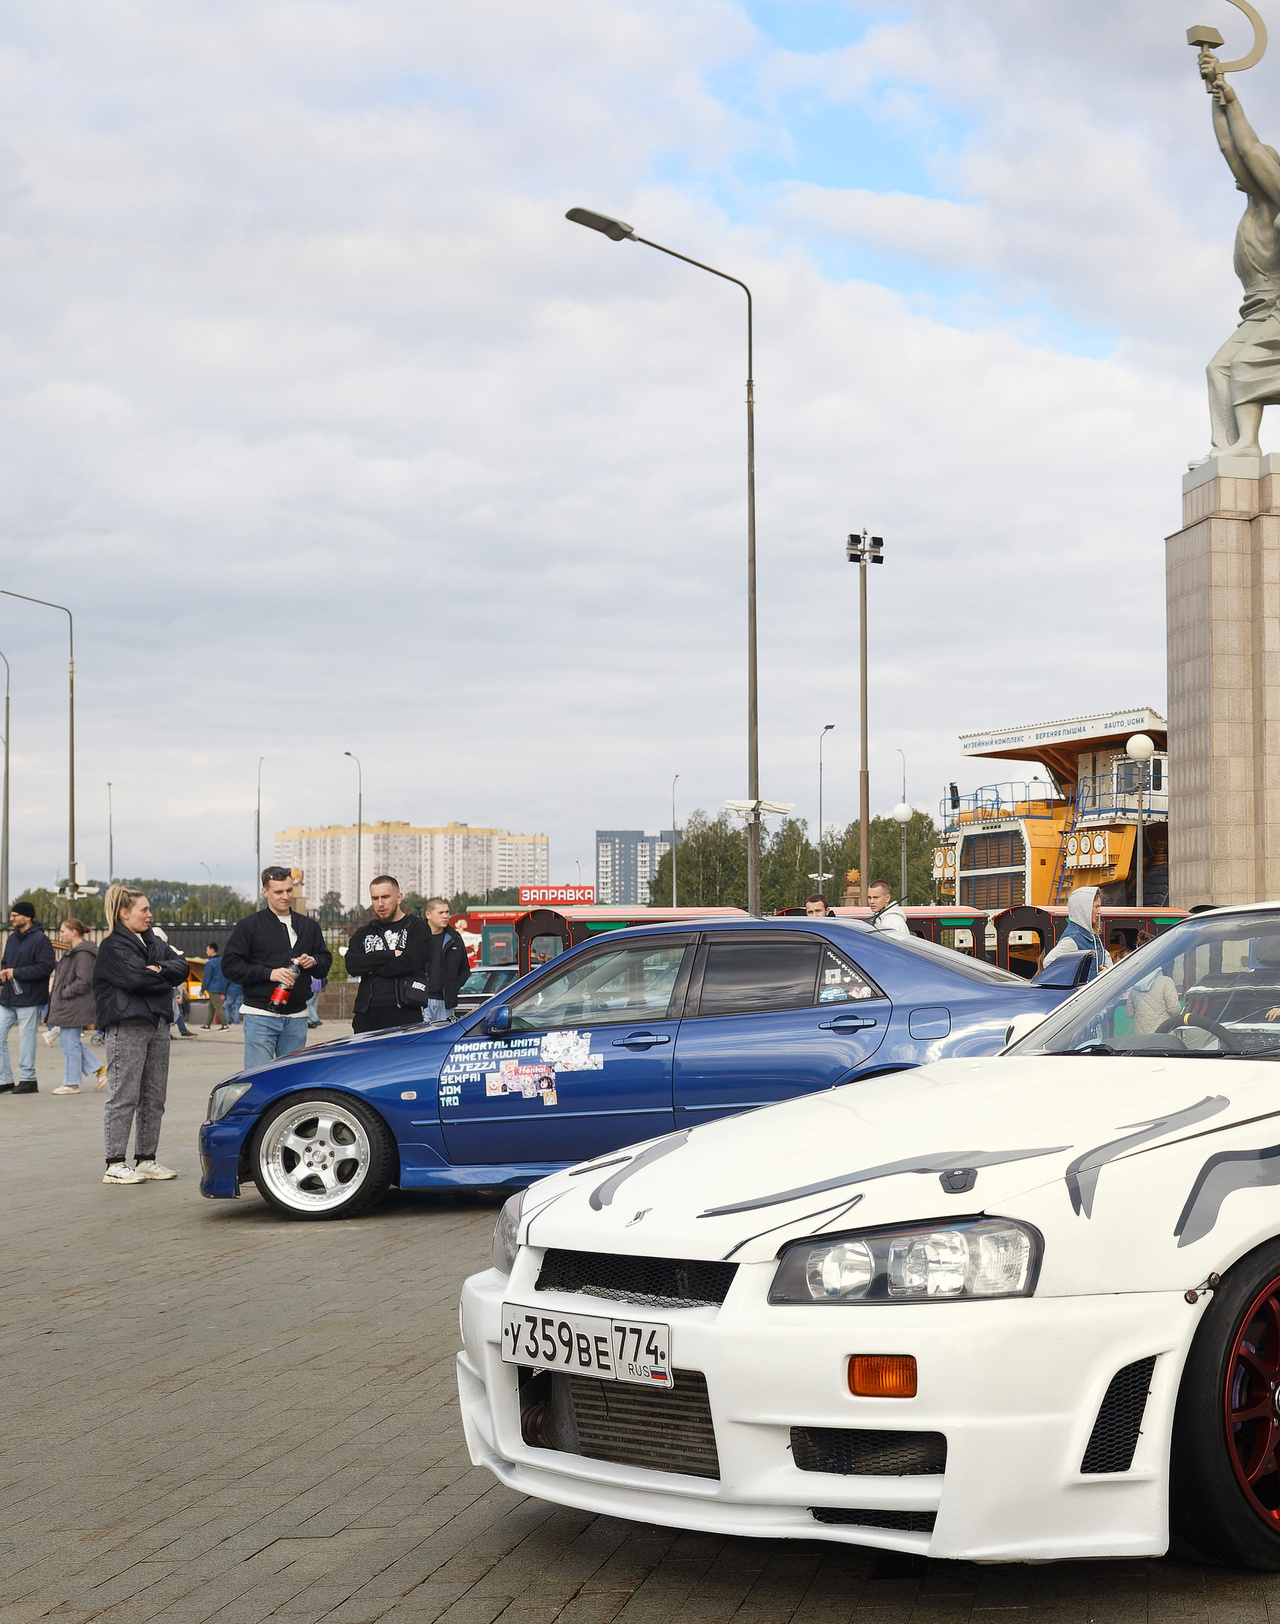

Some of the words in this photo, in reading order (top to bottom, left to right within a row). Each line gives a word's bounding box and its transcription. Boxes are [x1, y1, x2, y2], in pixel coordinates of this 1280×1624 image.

[1104, 716, 1146, 730] #AUTO_UGMK
[963, 737, 994, 750] МУЗЕЙНЫЙ
[994, 735, 1024, 746] КОМПЛЕКС
[1035, 729, 1062, 740] ВЕРХНЯЯ
[1062, 727, 1087, 737] ПЫШМА
[521, 889, 594, 901] ЗАПРАВКА
[454, 1040, 508, 1053] IMMORTAL
[510, 1037, 540, 1048] UNITS
[450, 1050, 490, 1063] YAMETE
[492, 1048, 539, 1060] KUDASAI
[443, 1061, 497, 1074] ALTEZZA
[518, 1066, 547, 1074] Hentai
[439, 1085, 462, 1096] JDM
[614, 1325, 659, 1365] 774
[628, 1363, 651, 1378] RUS
